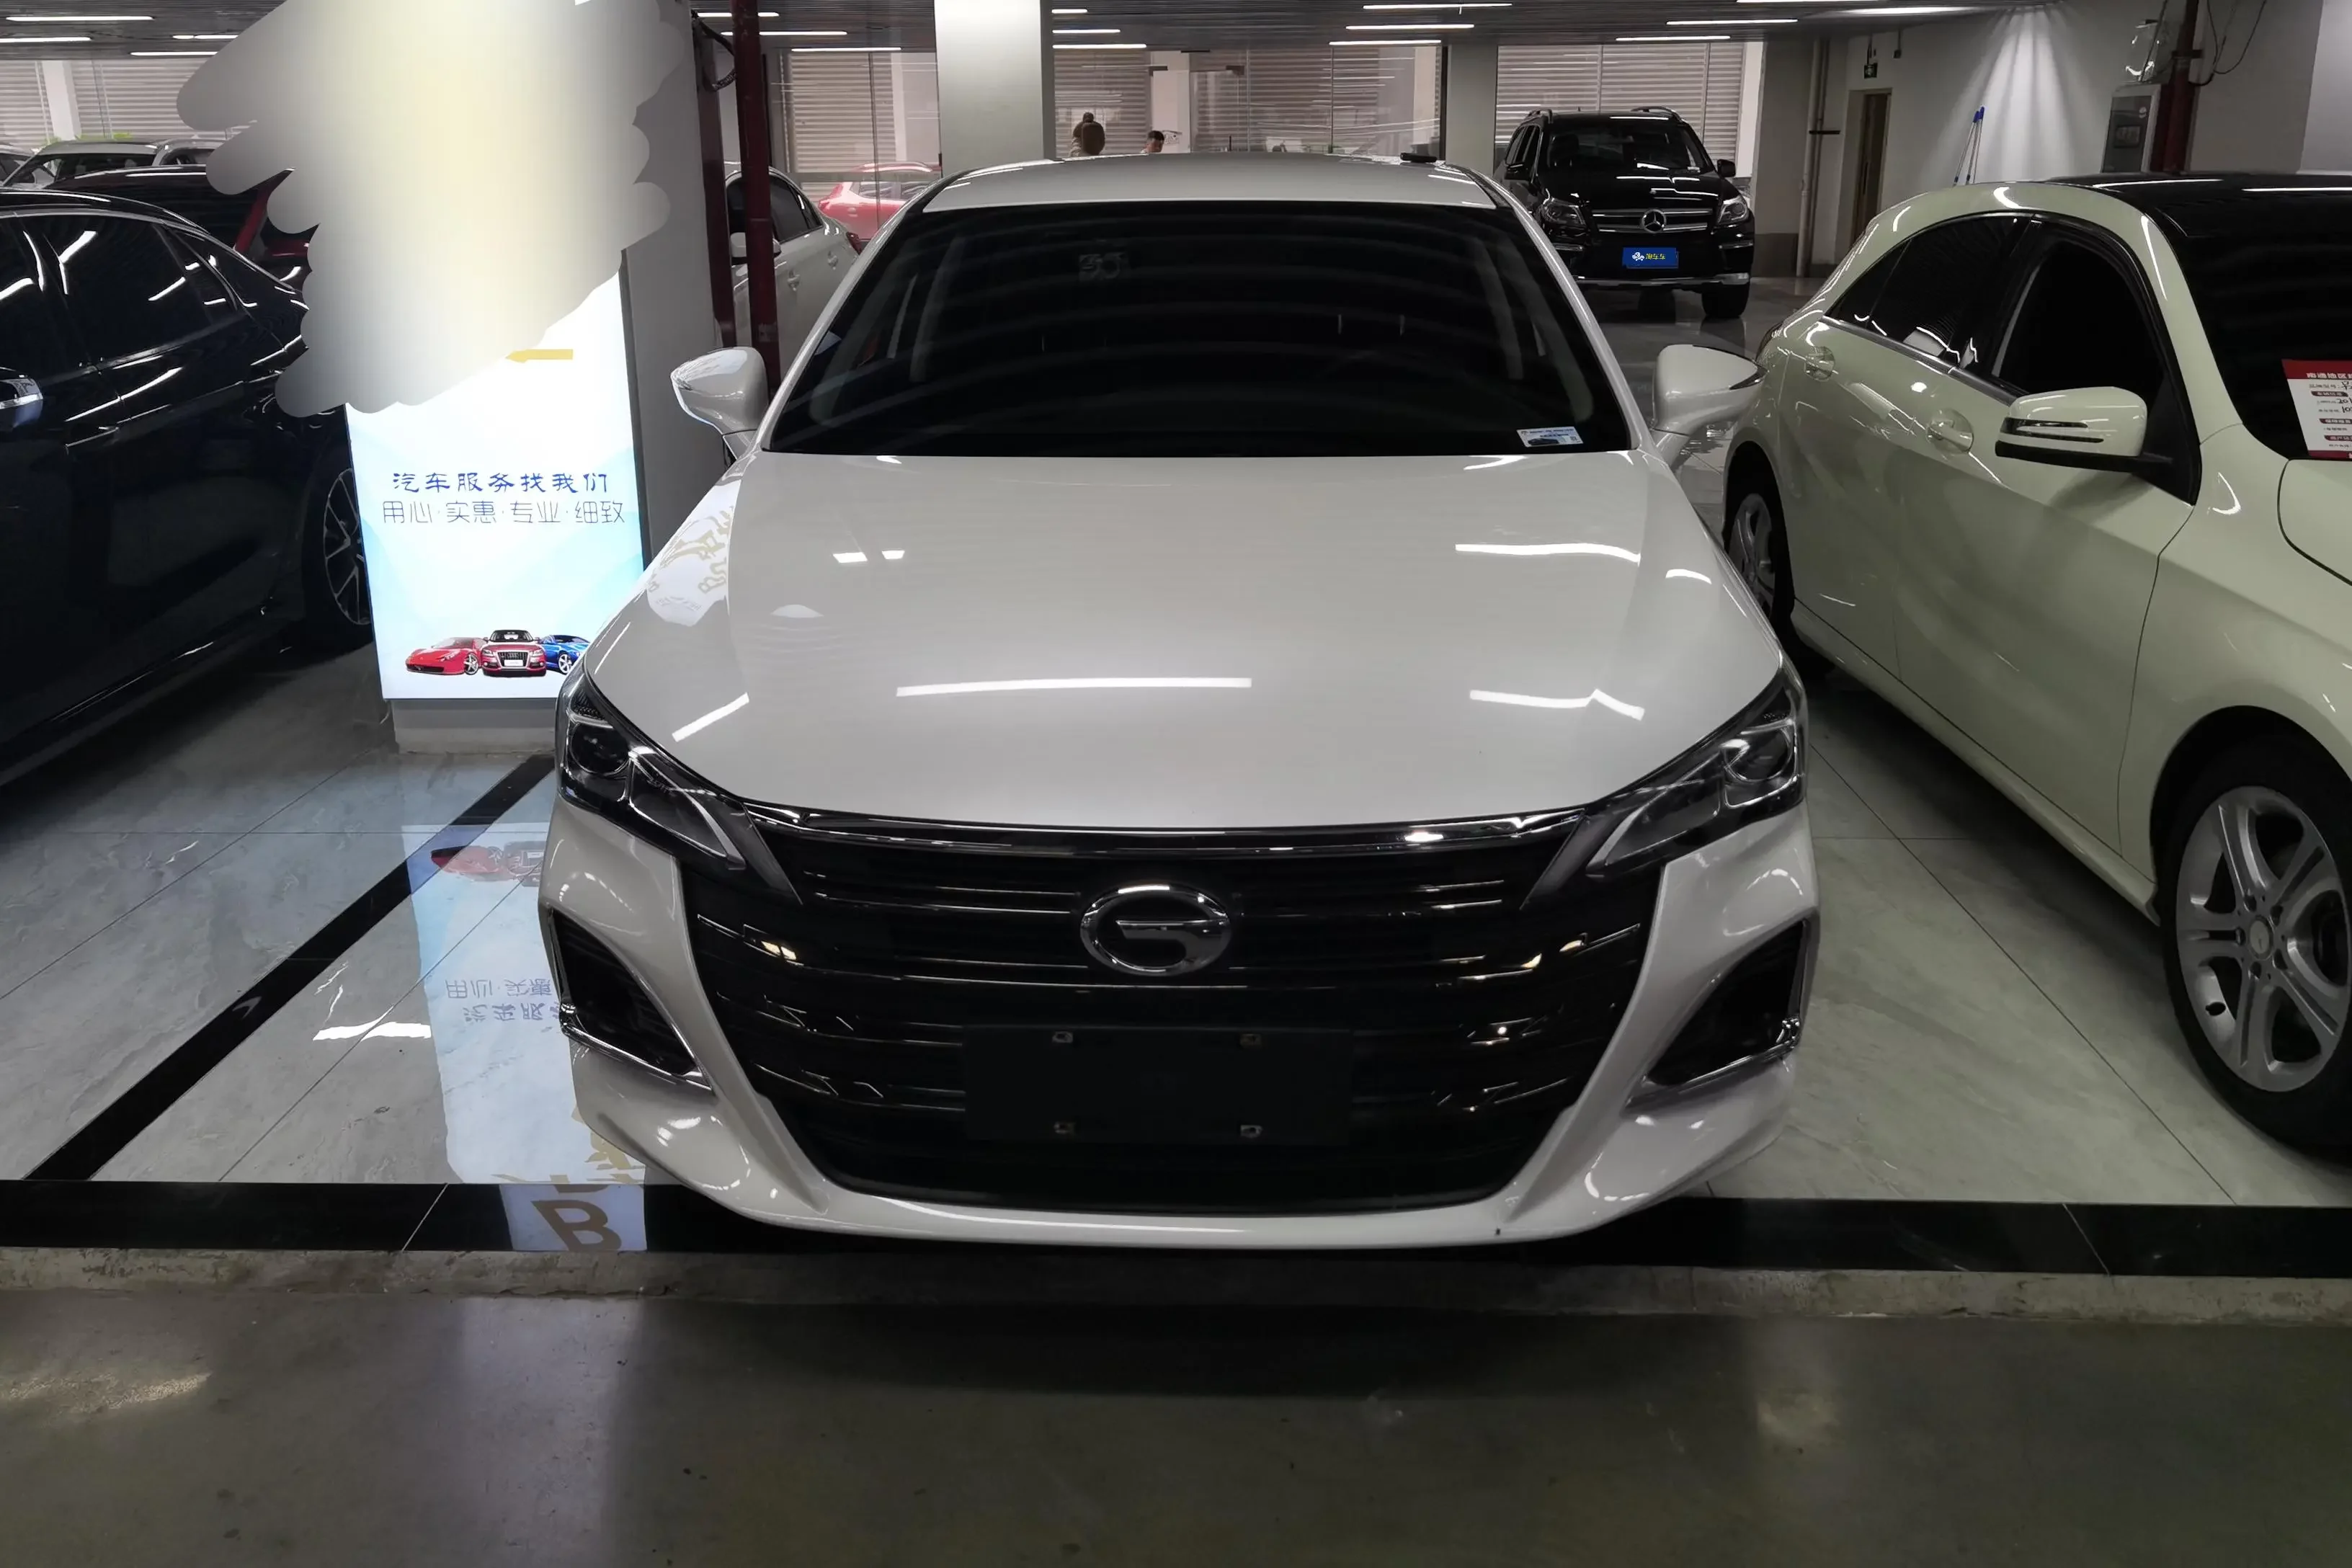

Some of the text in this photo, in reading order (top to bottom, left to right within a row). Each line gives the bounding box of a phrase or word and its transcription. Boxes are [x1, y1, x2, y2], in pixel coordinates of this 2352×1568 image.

[392, 472, 608, 494] 汽车服务找我们
